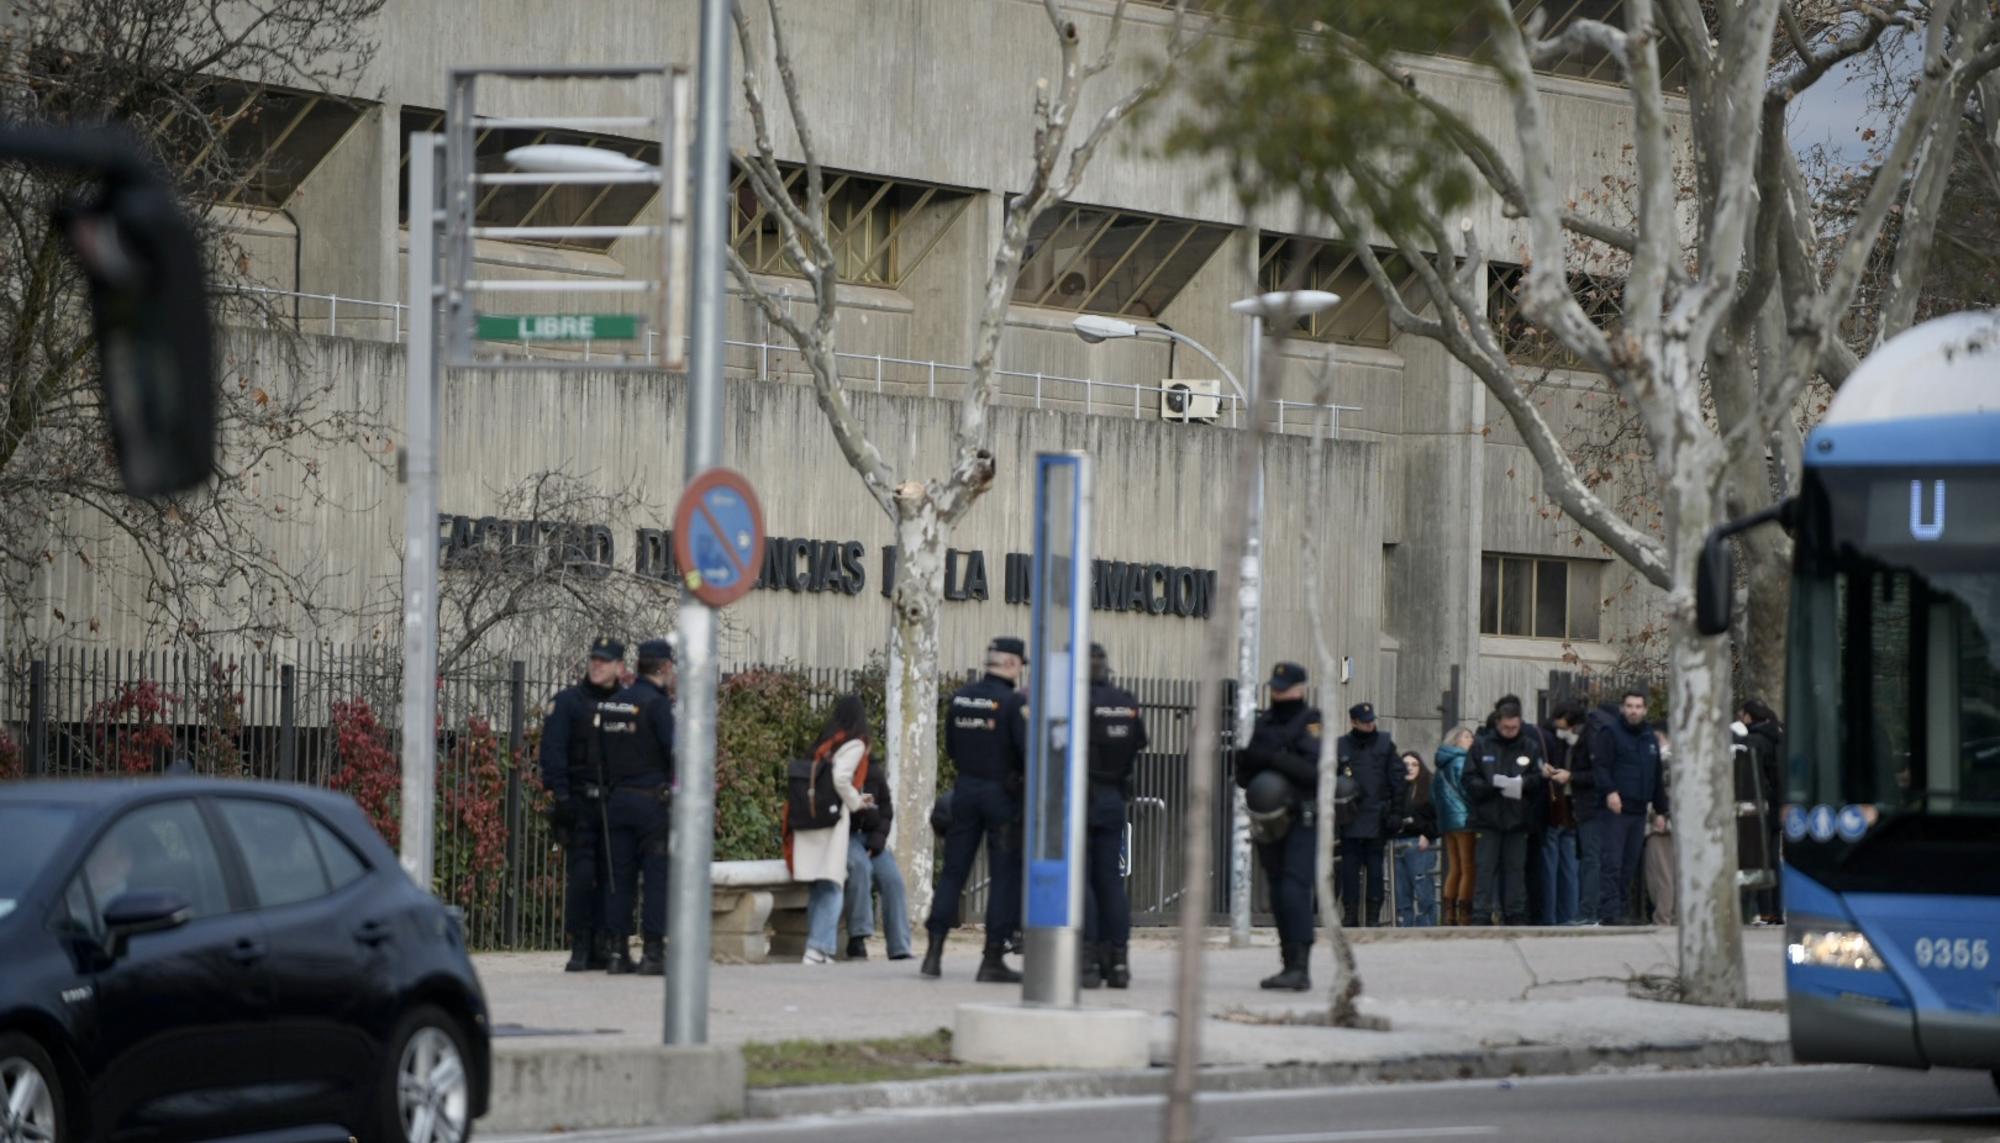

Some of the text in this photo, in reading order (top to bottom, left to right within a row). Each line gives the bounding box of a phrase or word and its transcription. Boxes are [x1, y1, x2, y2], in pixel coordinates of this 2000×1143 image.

[517, 316, 595, 339] LIBRE
[1910, 479, 1945, 540] U
[944, 548, 990, 602] LA
